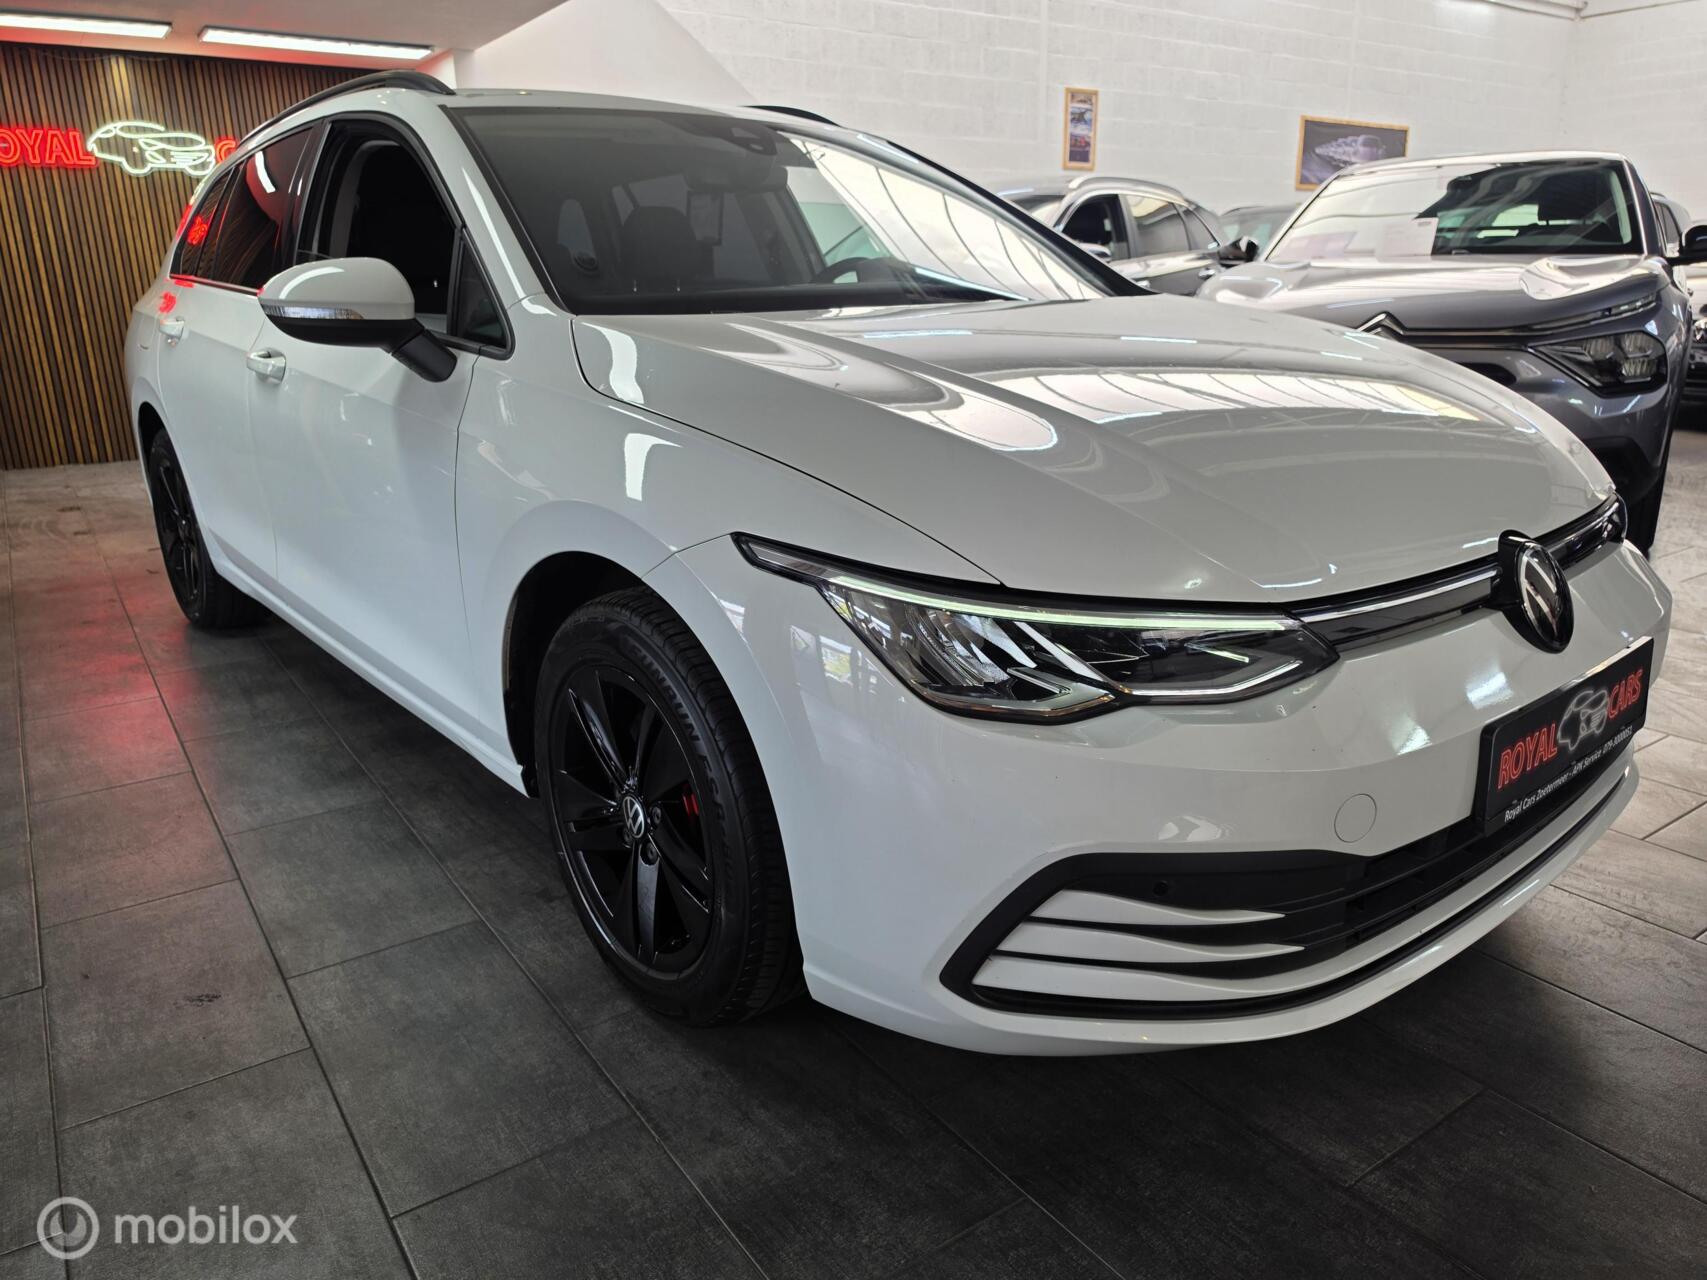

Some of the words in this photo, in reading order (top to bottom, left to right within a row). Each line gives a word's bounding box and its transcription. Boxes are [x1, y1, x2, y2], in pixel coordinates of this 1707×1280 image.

[1498, 723, 1558, 789] ROYAL
[1607, 669, 1643, 719] CARS
[1505, 800, 1523, 822] Royal
[1522, 794, 1536, 810] Cars
